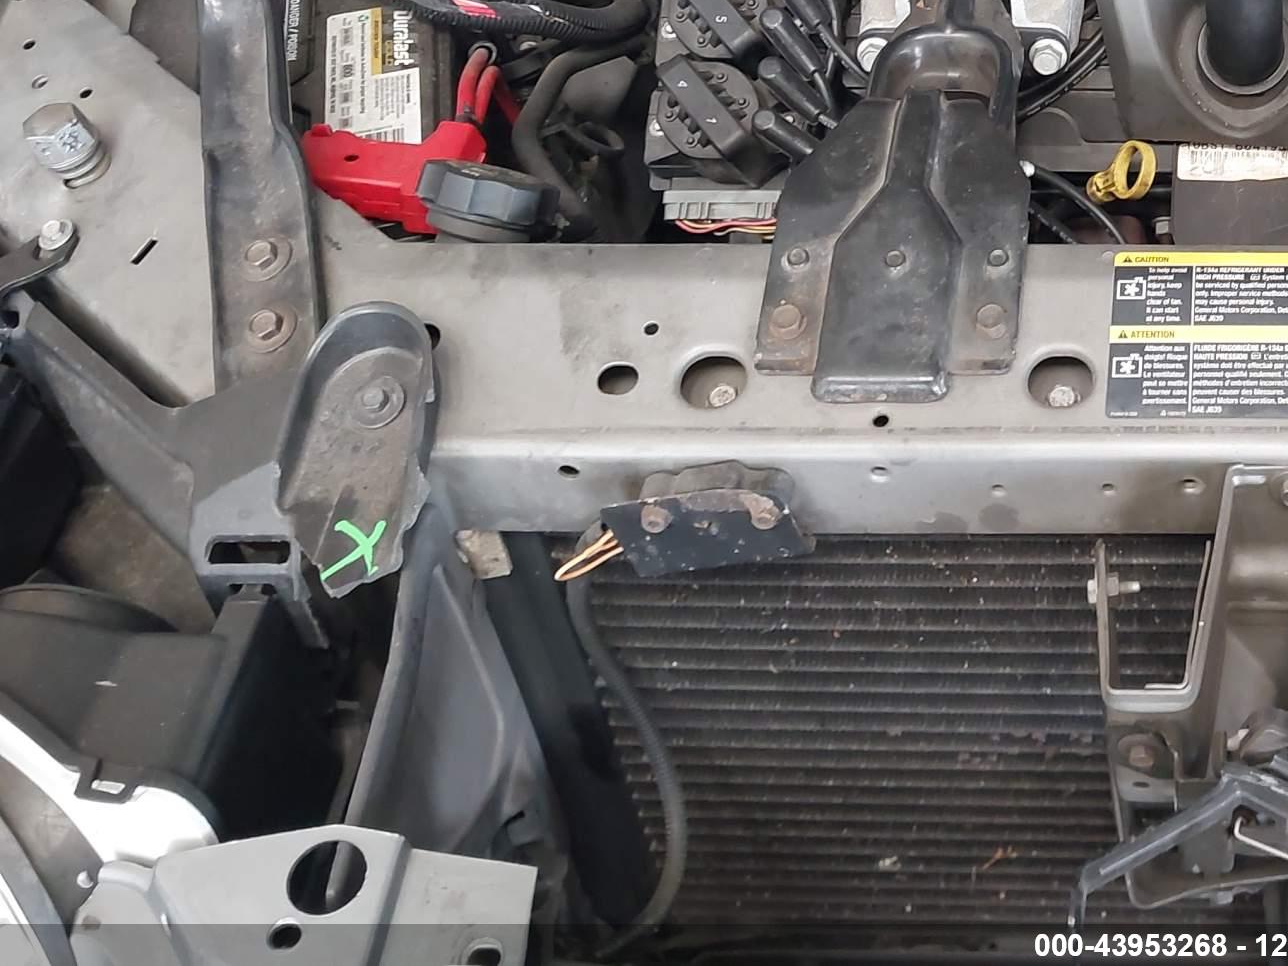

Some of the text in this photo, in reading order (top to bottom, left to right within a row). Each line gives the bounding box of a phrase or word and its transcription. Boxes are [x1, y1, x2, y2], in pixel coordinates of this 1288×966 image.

[289, 0, 301, 27] DANGER
[287, 34, 298, 60] POISON
[393, 11, 414, 65] Duralast
